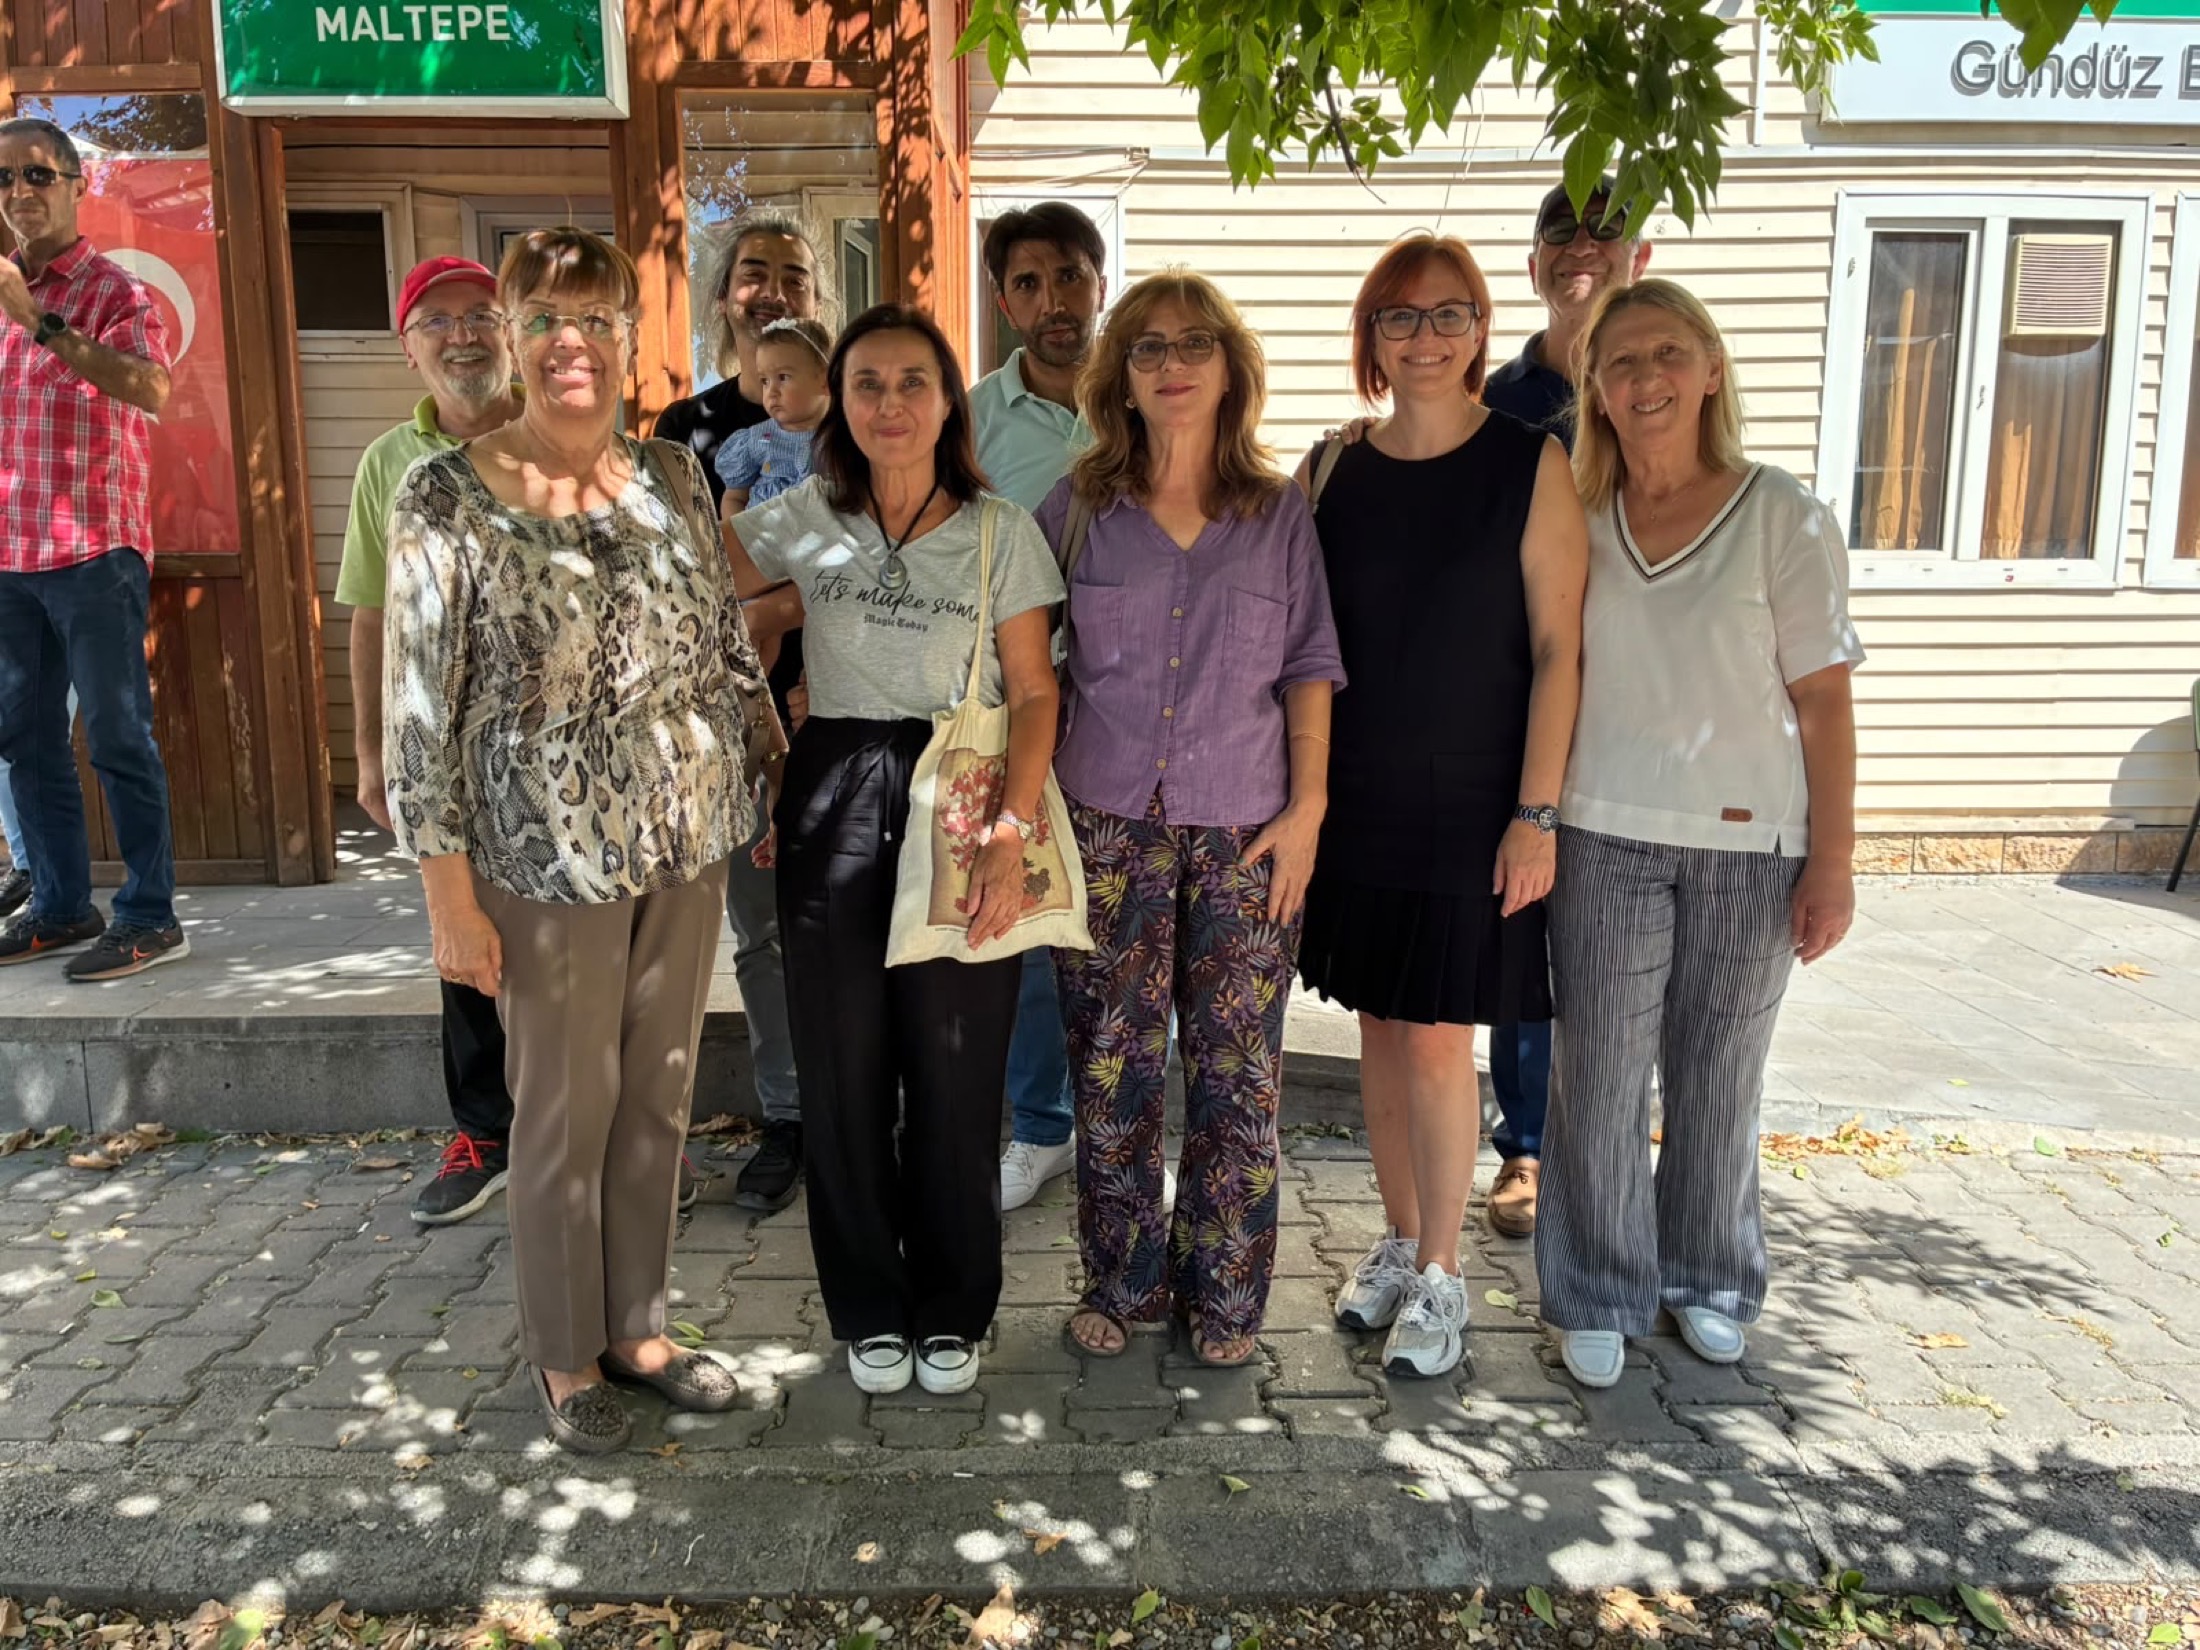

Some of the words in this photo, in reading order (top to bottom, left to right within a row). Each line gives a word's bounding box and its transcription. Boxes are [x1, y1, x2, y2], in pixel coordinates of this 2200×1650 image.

[315, 4, 511, 42] MALTEPE
[1950, 39, 2164, 98] Gündüz
[856, 580, 926, 616] make
